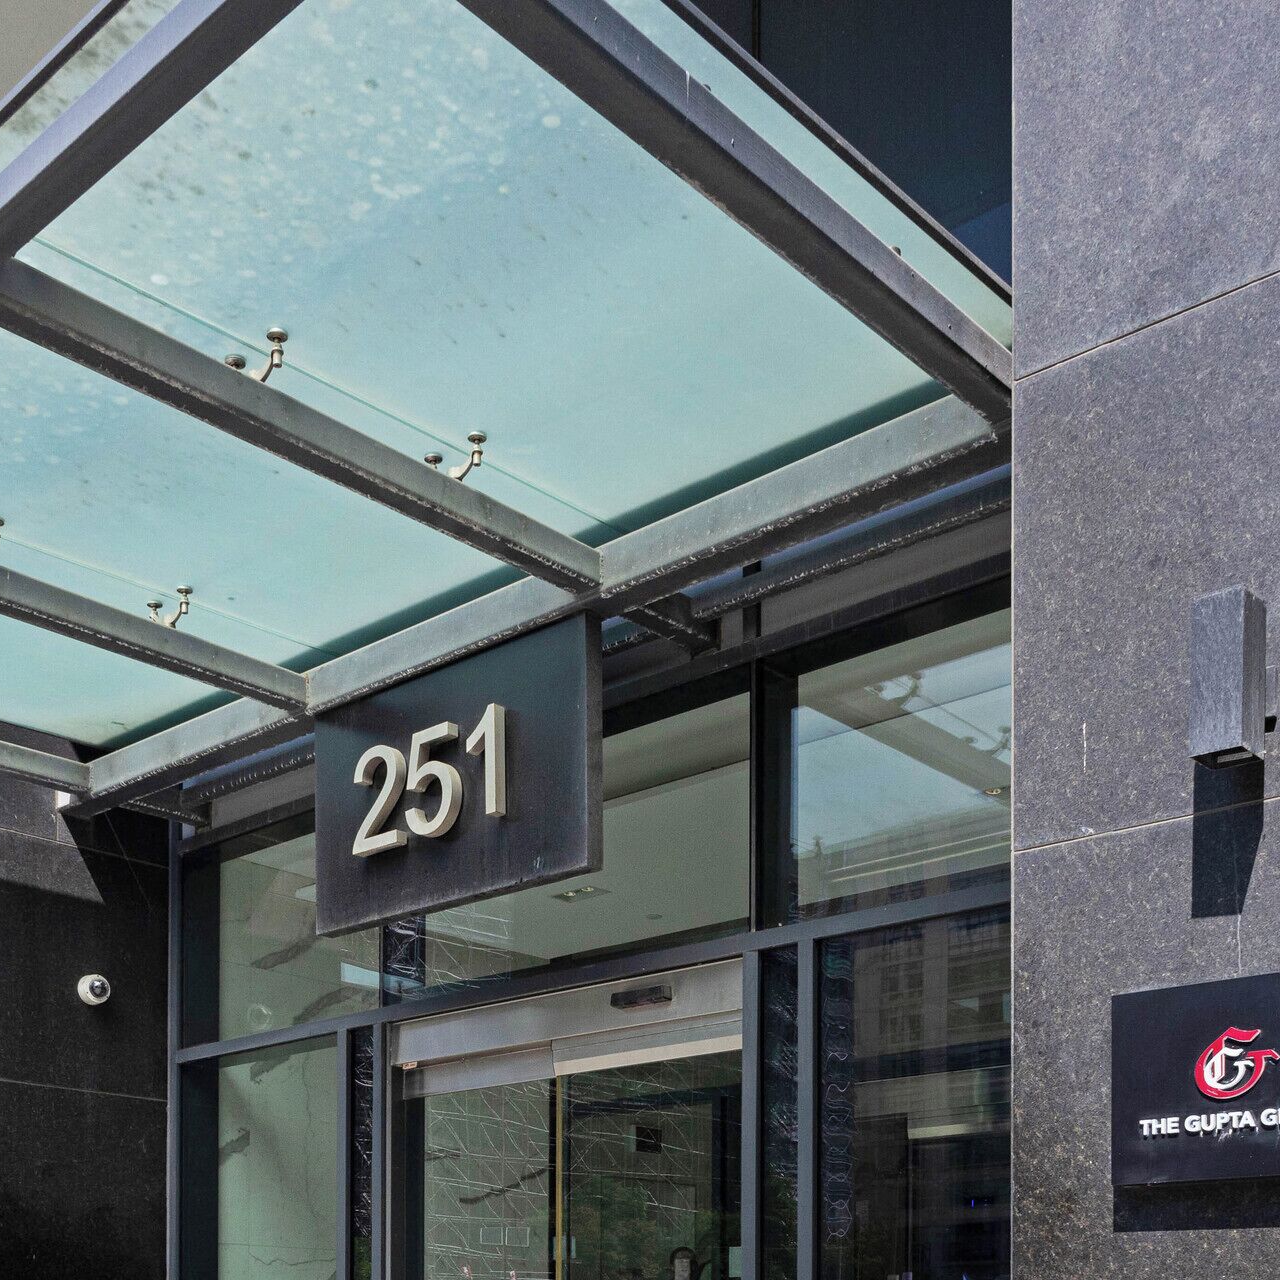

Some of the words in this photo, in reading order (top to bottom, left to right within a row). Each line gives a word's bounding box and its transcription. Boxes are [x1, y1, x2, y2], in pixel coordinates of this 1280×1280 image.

[352, 702, 506, 857] 251
[1139, 1116, 1180, 1136] THE
[1184, 1110, 1256, 1133] GUPTA
